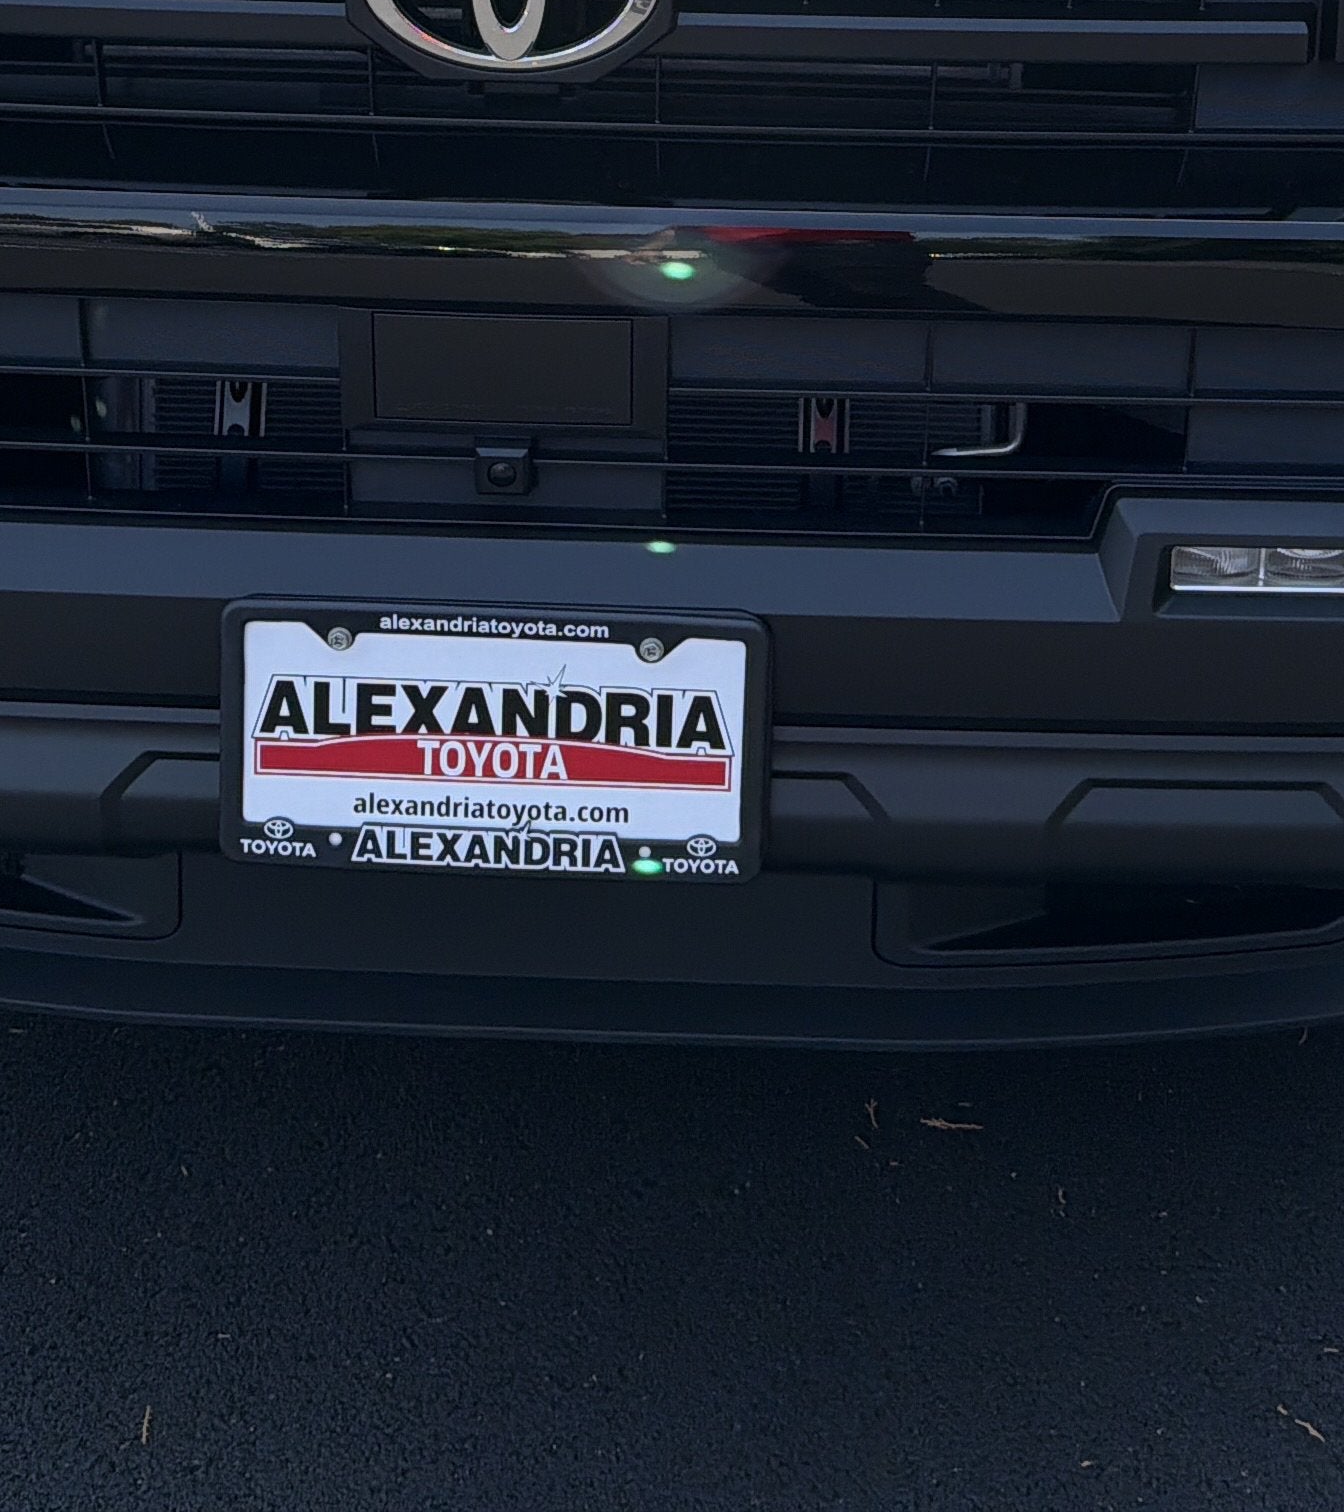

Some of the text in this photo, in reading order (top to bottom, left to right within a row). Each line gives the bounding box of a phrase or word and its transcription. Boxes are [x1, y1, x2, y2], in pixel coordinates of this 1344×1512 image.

[378, 613, 610, 639] alexandriatoyota.com
[257, 675, 730, 754] ALEXANDRIA
[415, 739, 568, 781] TOYOTA
[352, 791, 630, 825] alexandriatoyota.com
[239, 838, 317, 859] TOYOTA
[351, 824, 626, 873] ALEXANDRIA
[662, 857, 739, 876] TOYOTA
